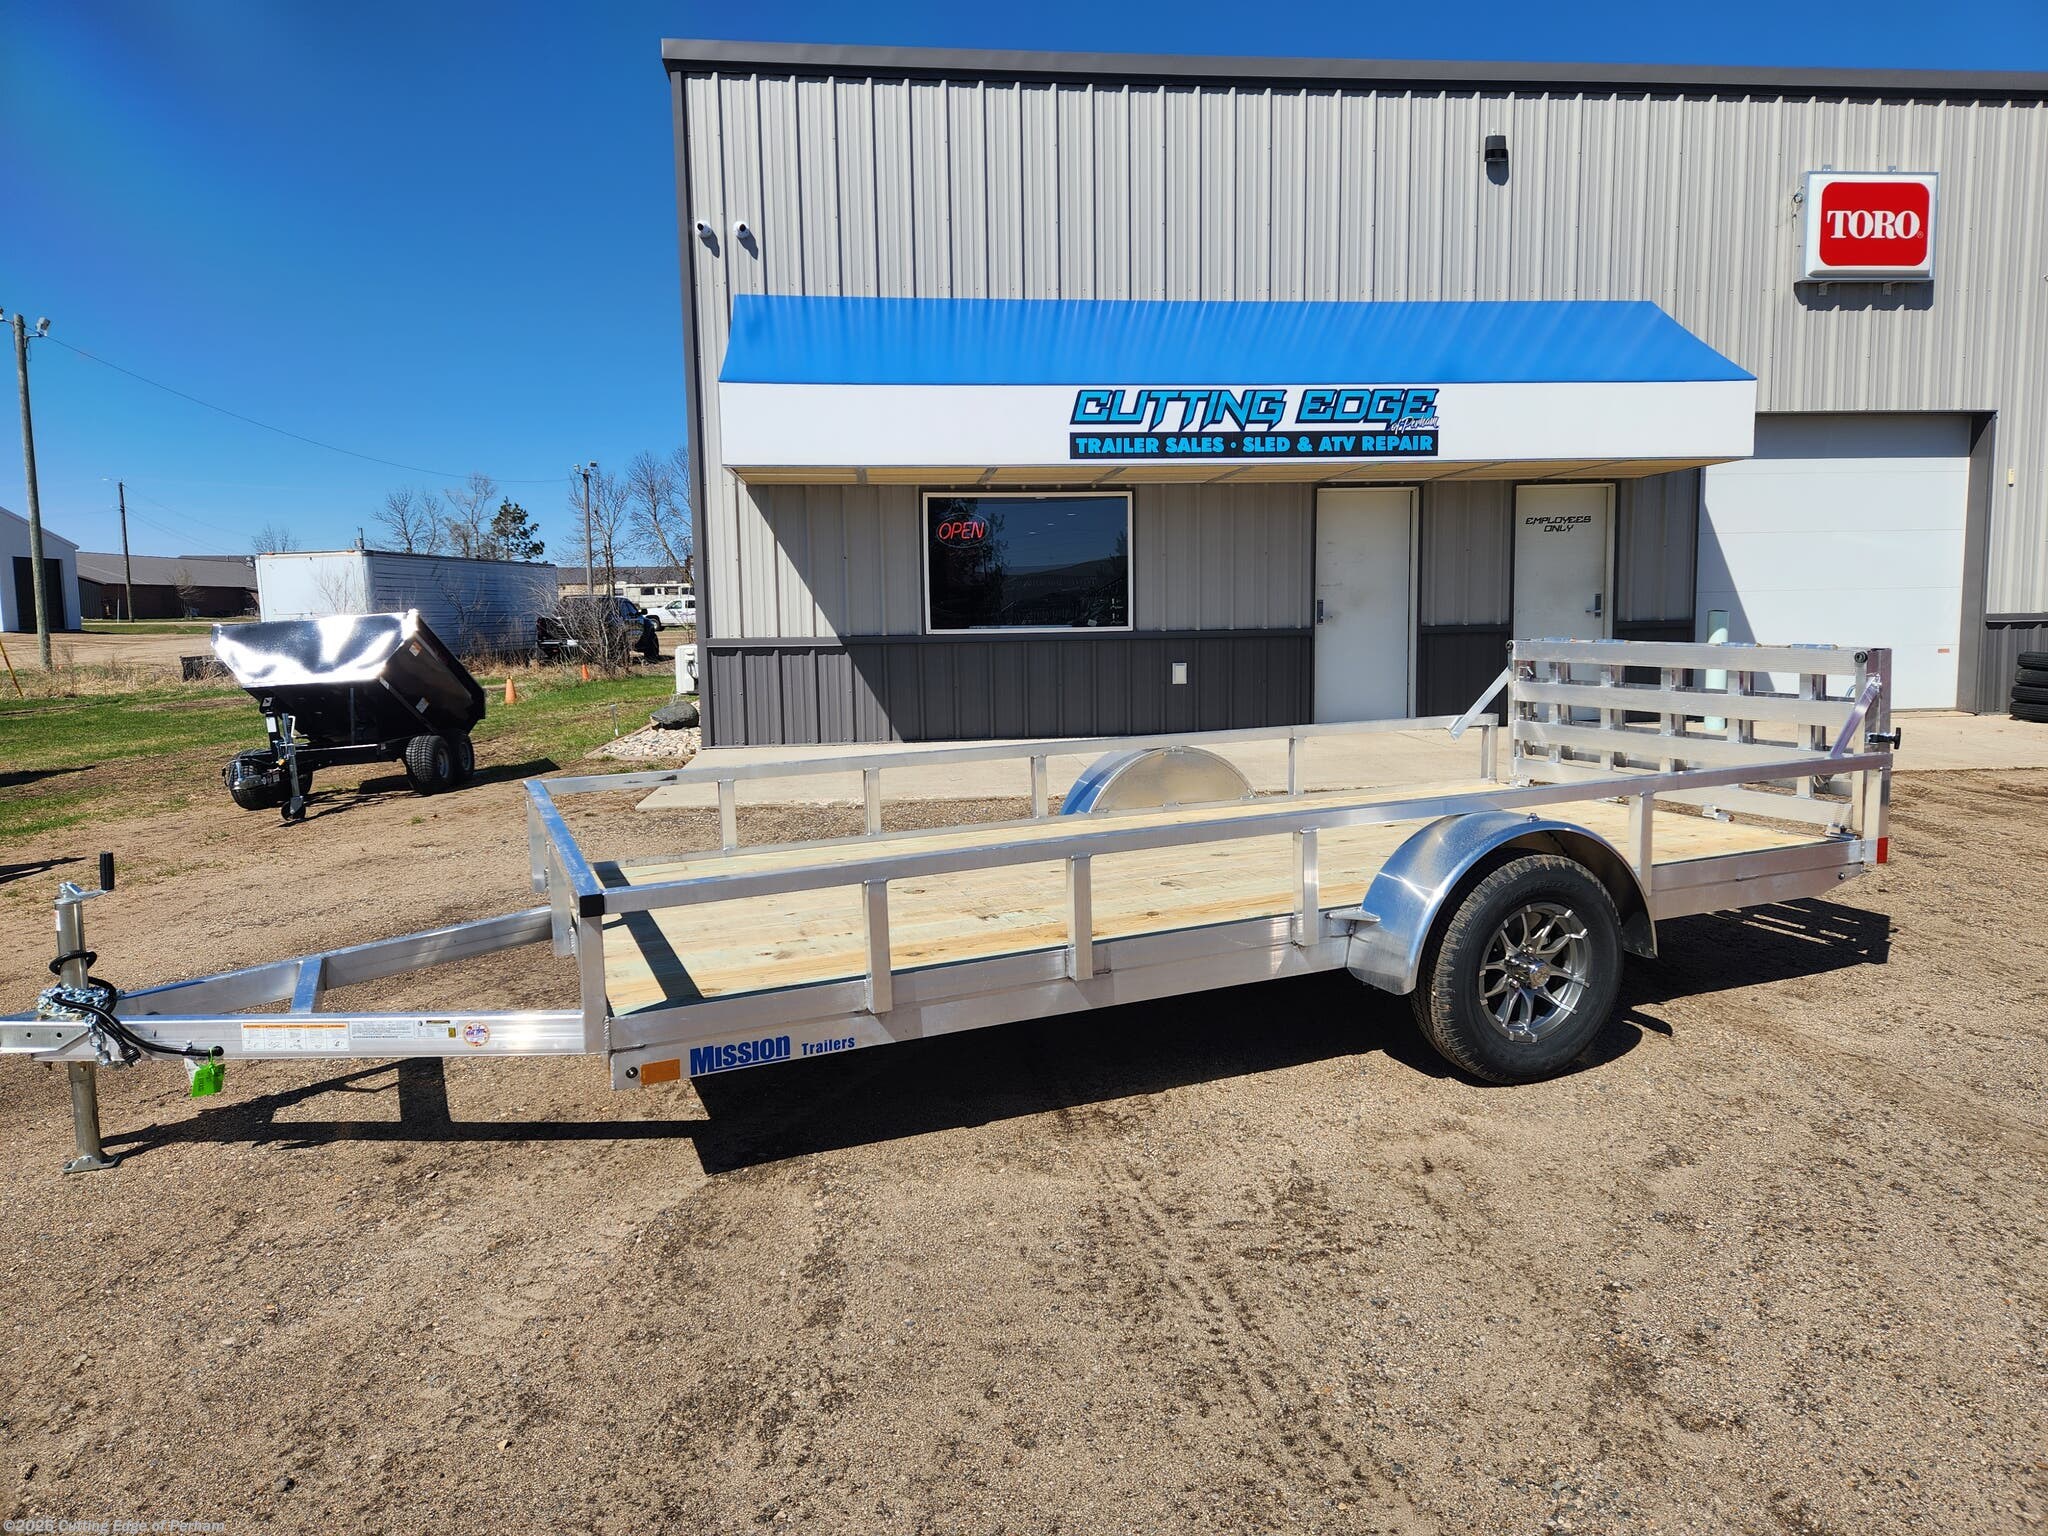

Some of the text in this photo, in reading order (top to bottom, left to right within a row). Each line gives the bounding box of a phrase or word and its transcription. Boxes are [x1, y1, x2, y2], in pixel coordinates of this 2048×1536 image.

[1826, 210, 1921, 240] TORO
[1070, 388, 1439, 433] CUTTING EDGE
[1391, 415, 1440, 435] of Perham
[1075, 435, 1433, 454] TRAILER SALES SLED & ATV REPAIR
[1525, 515, 1592, 525] EMPLOYEES
[1543, 524, 1575, 533] ONLY
[938, 521, 985, 541] OPEN
[801, 1036, 856, 1056] Trailers
